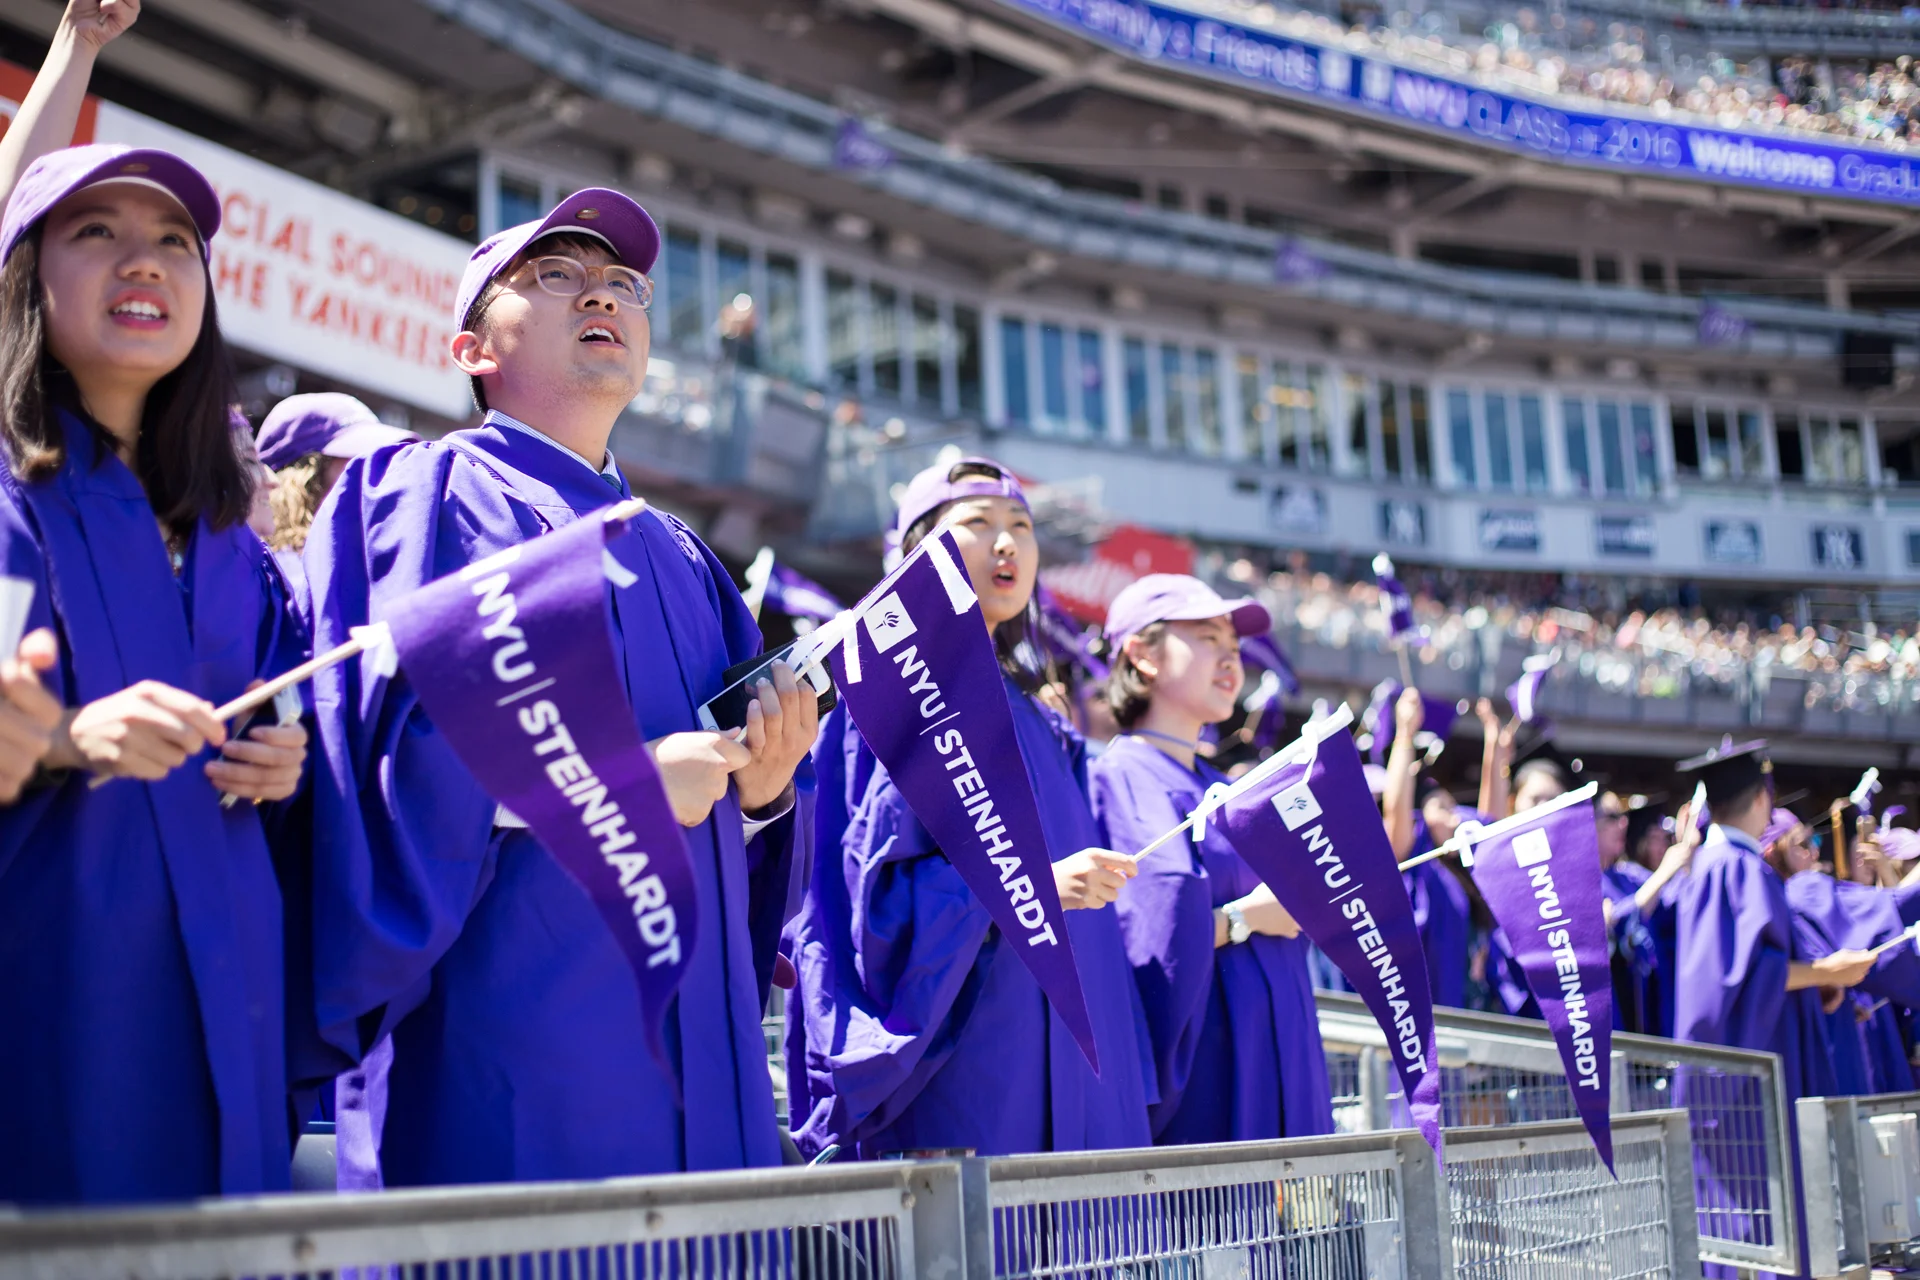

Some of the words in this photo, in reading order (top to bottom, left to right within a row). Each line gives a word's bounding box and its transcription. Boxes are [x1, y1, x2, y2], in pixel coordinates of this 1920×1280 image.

[1193, 20, 1319, 92] Friends
[1391, 70, 1469, 128] NYU
[1467, 91, 1571, 155] CLASS
[1688, 131, 1836, 189] Welcome
[213, 182, 314, 266] CIAL
[209, 247, 270, 310] HE
[289, 272, 453, 370] YANKEES
[473, 571, 536, 684] NYU
[518, 699, 681, 969] STEINHARDT
[892, 644, 946, 719] NYU
[934, 728, 1059, 948] STEINHARDT
[1301, 824, 1351, 889] NYU
[1342, 897, 1429, 1075] STEINHARDT
[1527, 864, 1564, 920] NYU
[1547, 928, 1600, 1091] STEINHARDT
